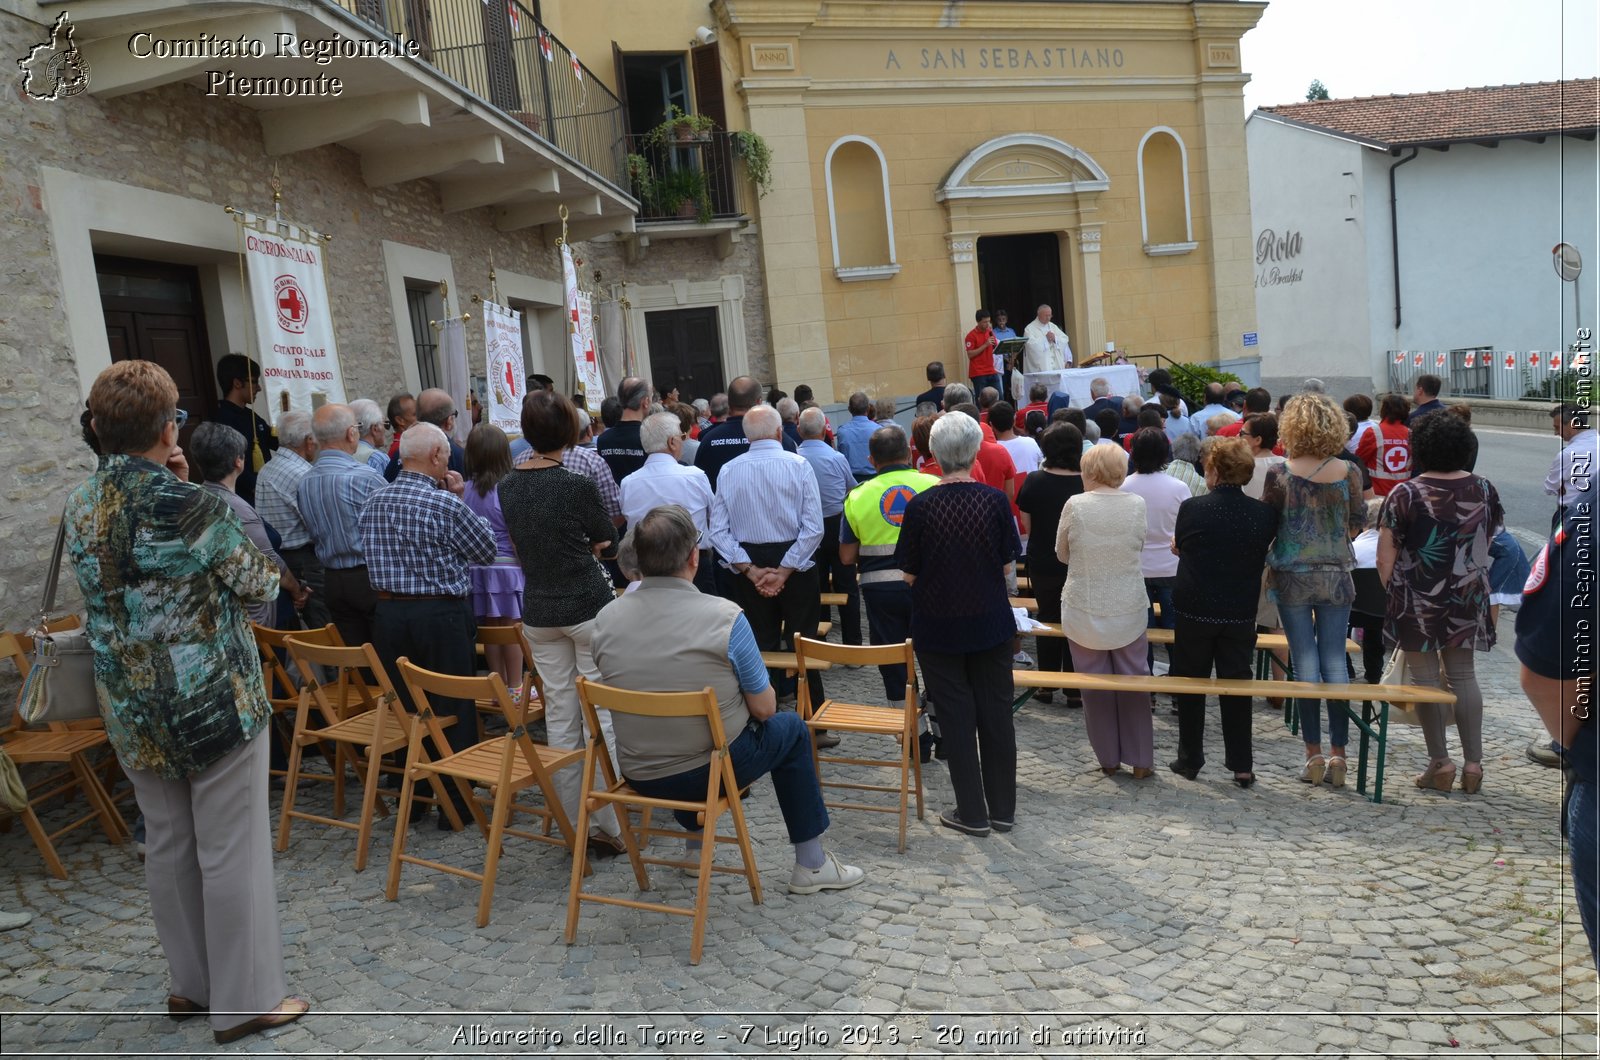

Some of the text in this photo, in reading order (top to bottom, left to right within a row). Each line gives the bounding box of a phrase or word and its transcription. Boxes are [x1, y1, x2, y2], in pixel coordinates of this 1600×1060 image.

[759, 52, 785, 62] ANNO
[886, 47, 1124, 69] A SAN SEBASTIANO
[294, 357, 305, 366] DI
[725, 437, 741, 445] ROSSA
